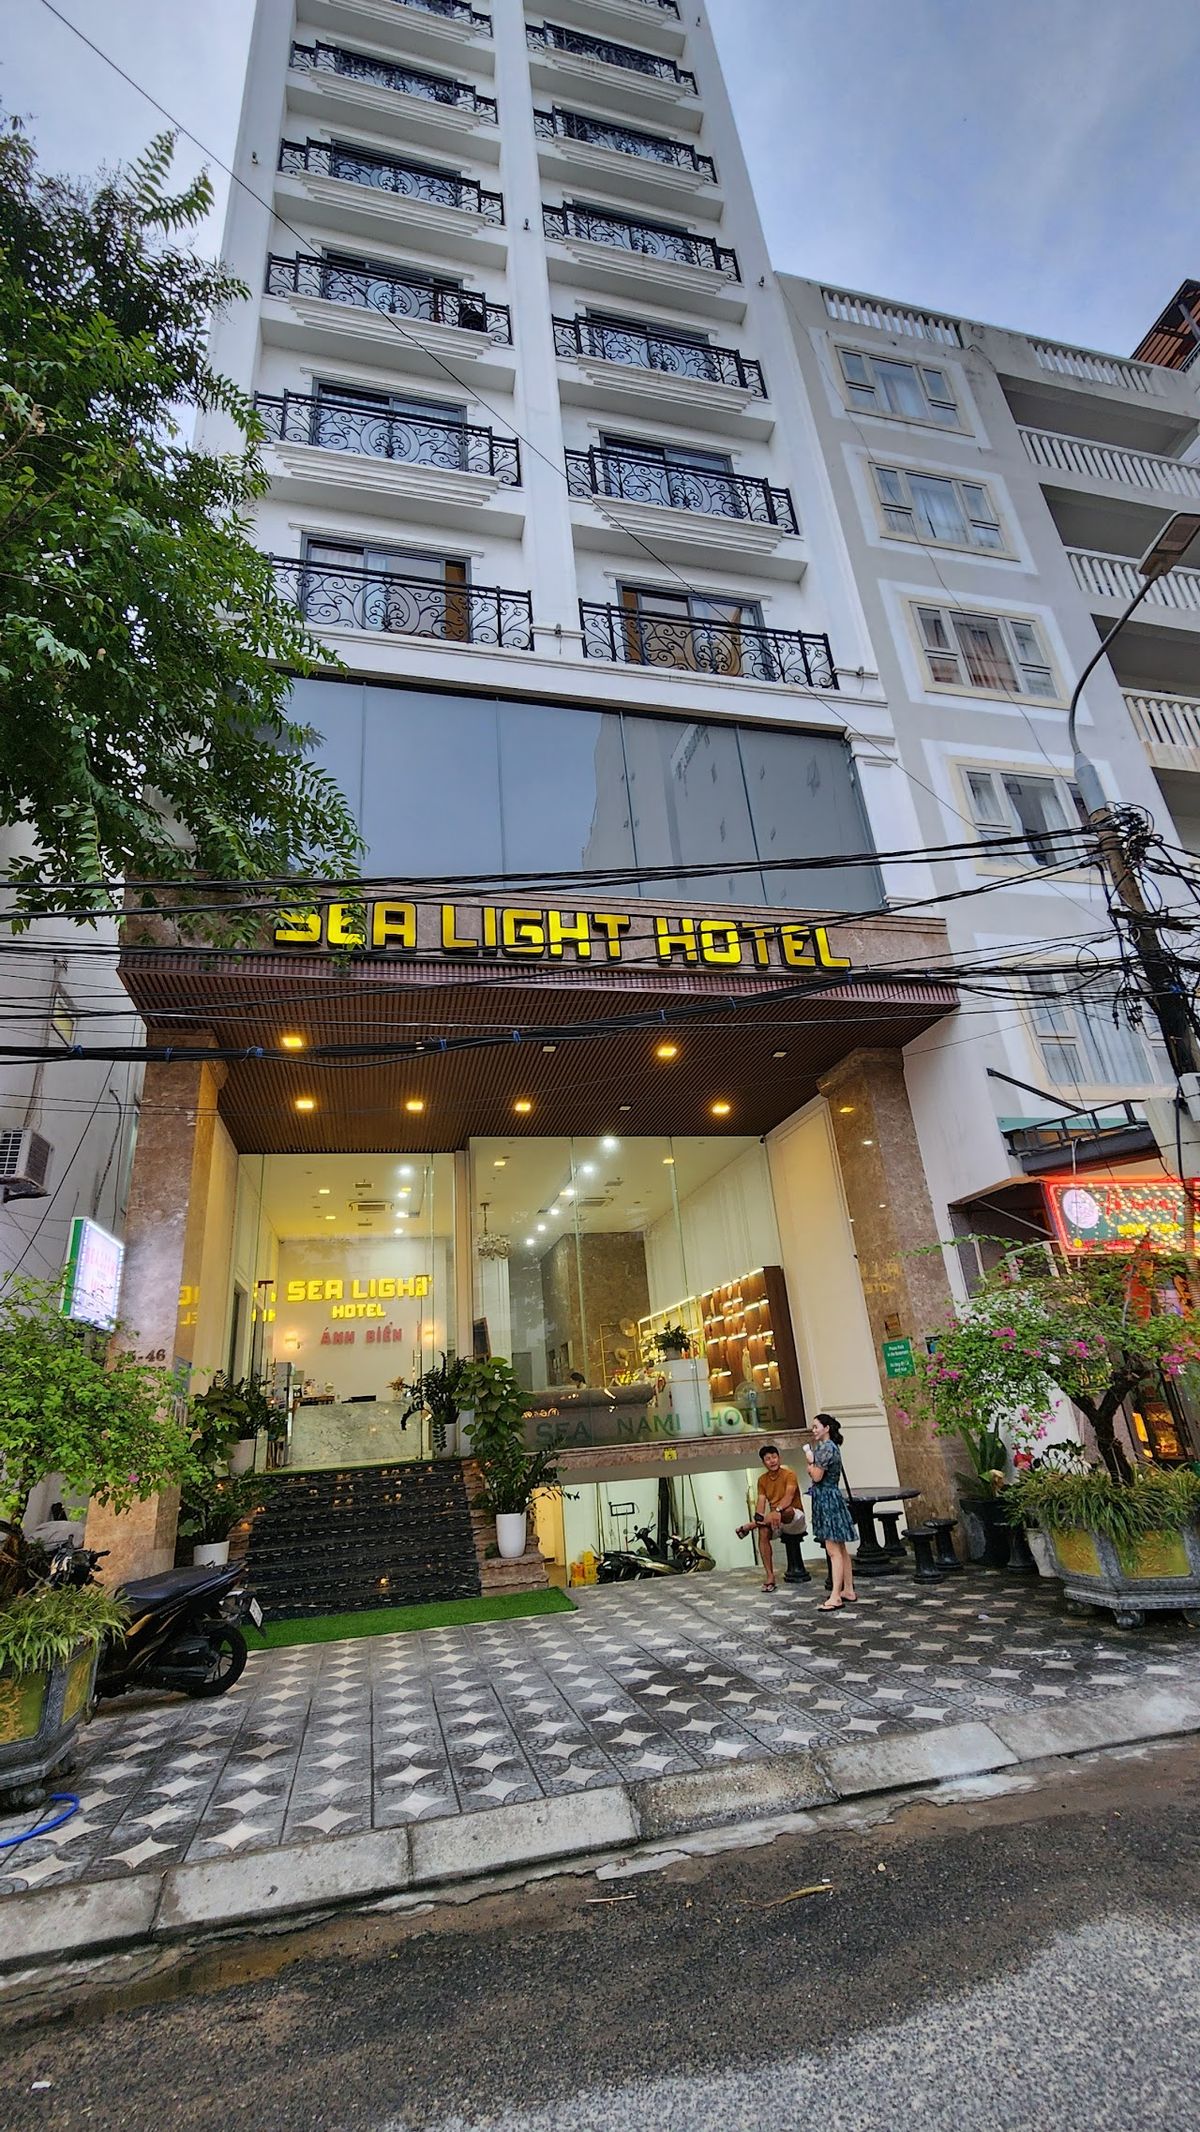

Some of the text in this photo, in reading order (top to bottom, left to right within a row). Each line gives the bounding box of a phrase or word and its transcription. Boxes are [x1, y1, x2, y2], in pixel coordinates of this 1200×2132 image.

[275, 901, 851, 967] SEA LIGHT HOTEL
[287, 1279, 343, 1302] SEA
[352, 1276, 432, 1299] LIGHT
[332, 1303, 386, 1319] HOTEL
[320, 1327, 355, 1345] ÁNH
[535, 1405, 786, 1444] SEA NAMI HOTEL
